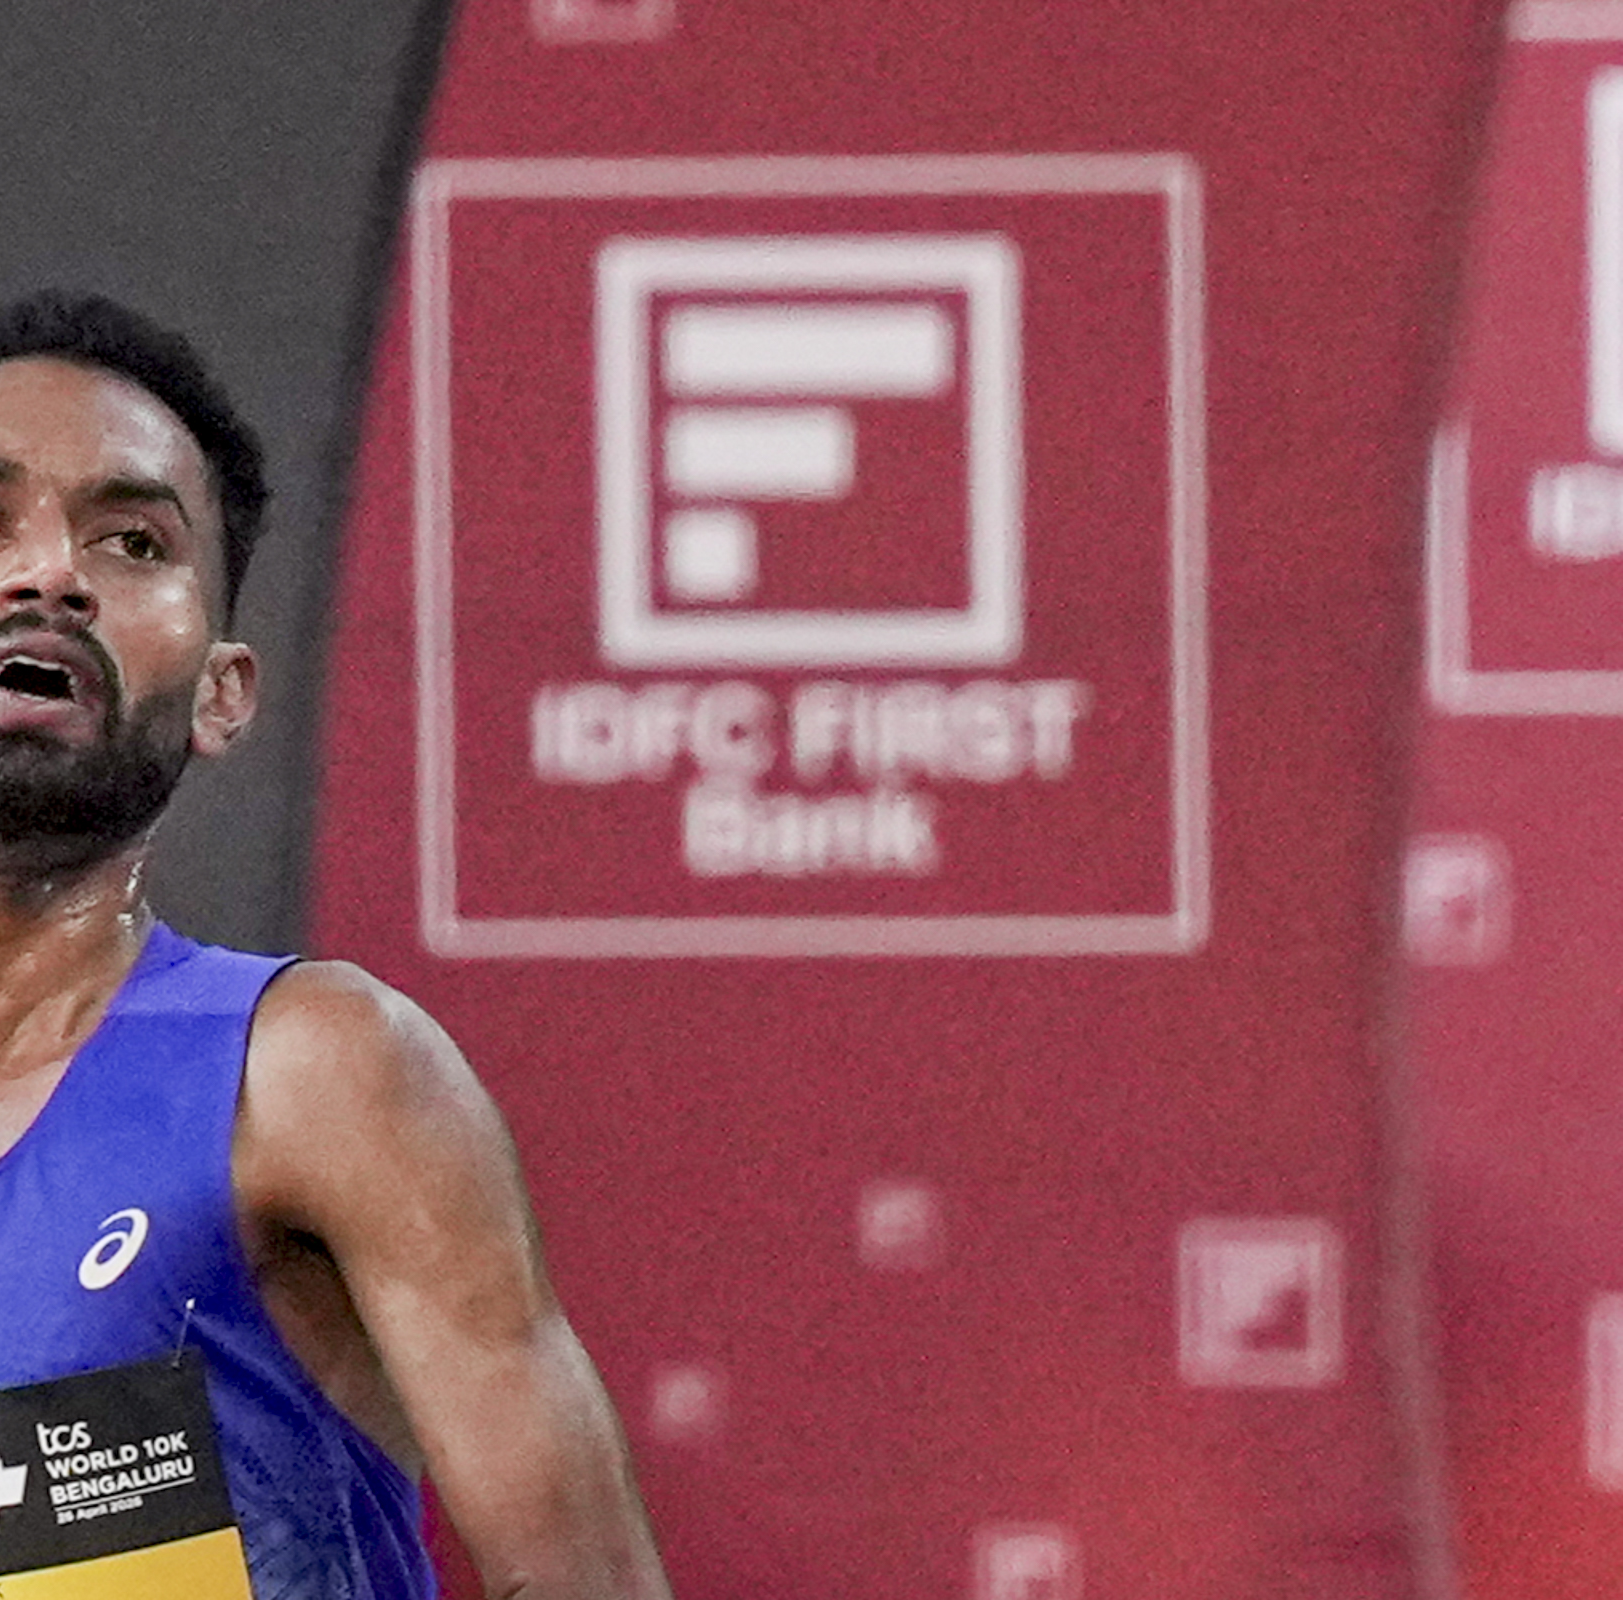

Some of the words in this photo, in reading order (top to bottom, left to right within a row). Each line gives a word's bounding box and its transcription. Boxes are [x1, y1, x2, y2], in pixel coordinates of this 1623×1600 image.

[531, 680, 780, 784] IDFC
[789, 680, 1091, 784] FIRST
[684, 792, 938, 878] Bank
[36, 1421, 92, 1456] tcs
[45, 1444, 139, 1479] WORLD
[142, 1430, 189, 1459] 10K
[49, 1455, 194, 1505] BENGALURU
